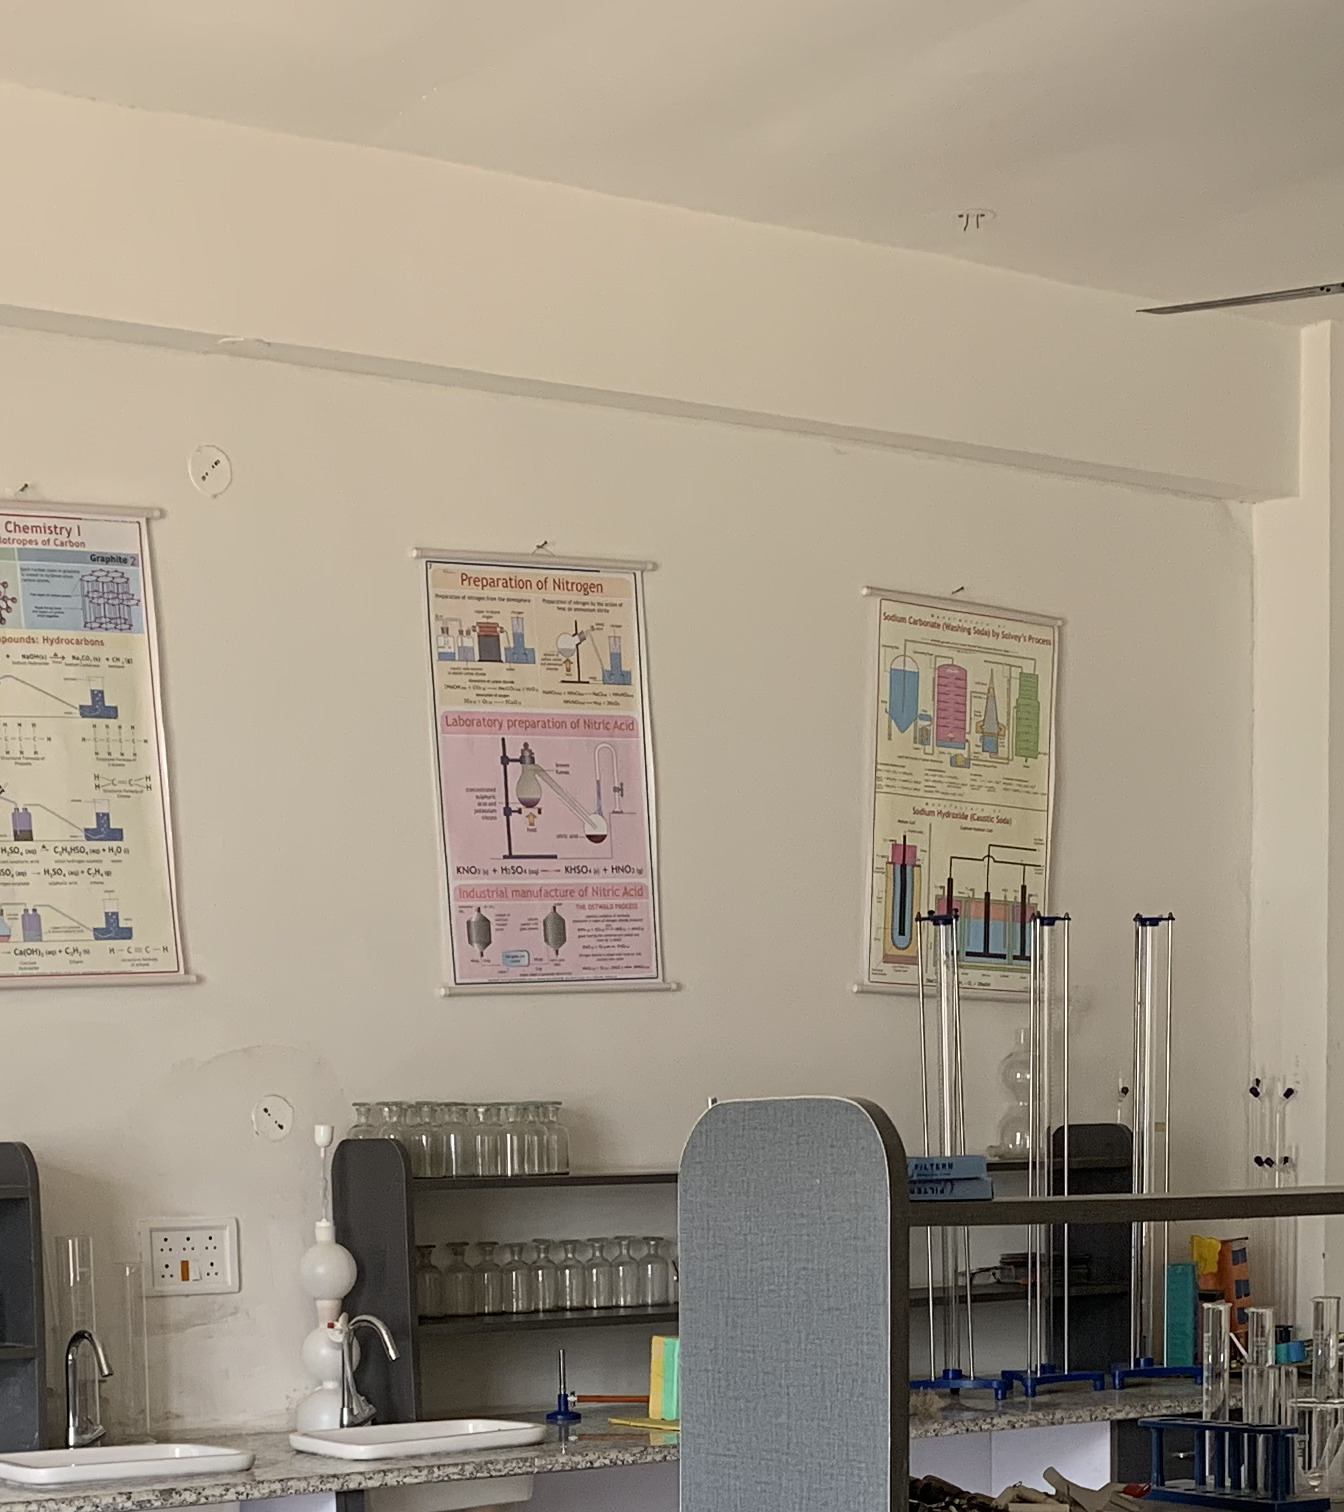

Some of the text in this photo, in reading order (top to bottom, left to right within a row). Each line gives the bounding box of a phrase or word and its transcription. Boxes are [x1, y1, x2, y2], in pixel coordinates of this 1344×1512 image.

[5, 521, 72, 538] Chemistry
[77, 525, 81, 536] I
[41, 538, 52, 546] of
[54, 538, 86, 548] Carbon
[90, 554, 128, 565] Graphite
[461, 573, 603, 596] Preparation of Nitrogen
[883, 612, 907, 623] Sodium
[908, 616, 941, 629] Carbonate
[943, 622, 971, 635] (Washing
[973, 626, 990, 638] Soda)
[992, 630, 999, 639] by
[1001, 631, 1026, 643] Solvey's
[1028, 634, 1051, 646] Process
[42, 635, 104, 647] Hydrocarbons
[445, 715, 635, 731] Laboratory preparation of Nitric Acid
[912, 807, 936, 817] Sodium
[937, 808, 968, 822] Hydroxide
[970, 812, 994, 823] (Caustic
[996, 815, 1012, 826] Soda)
[459, 886, 643, 898] Industrial manufacture of Nitric Acid
